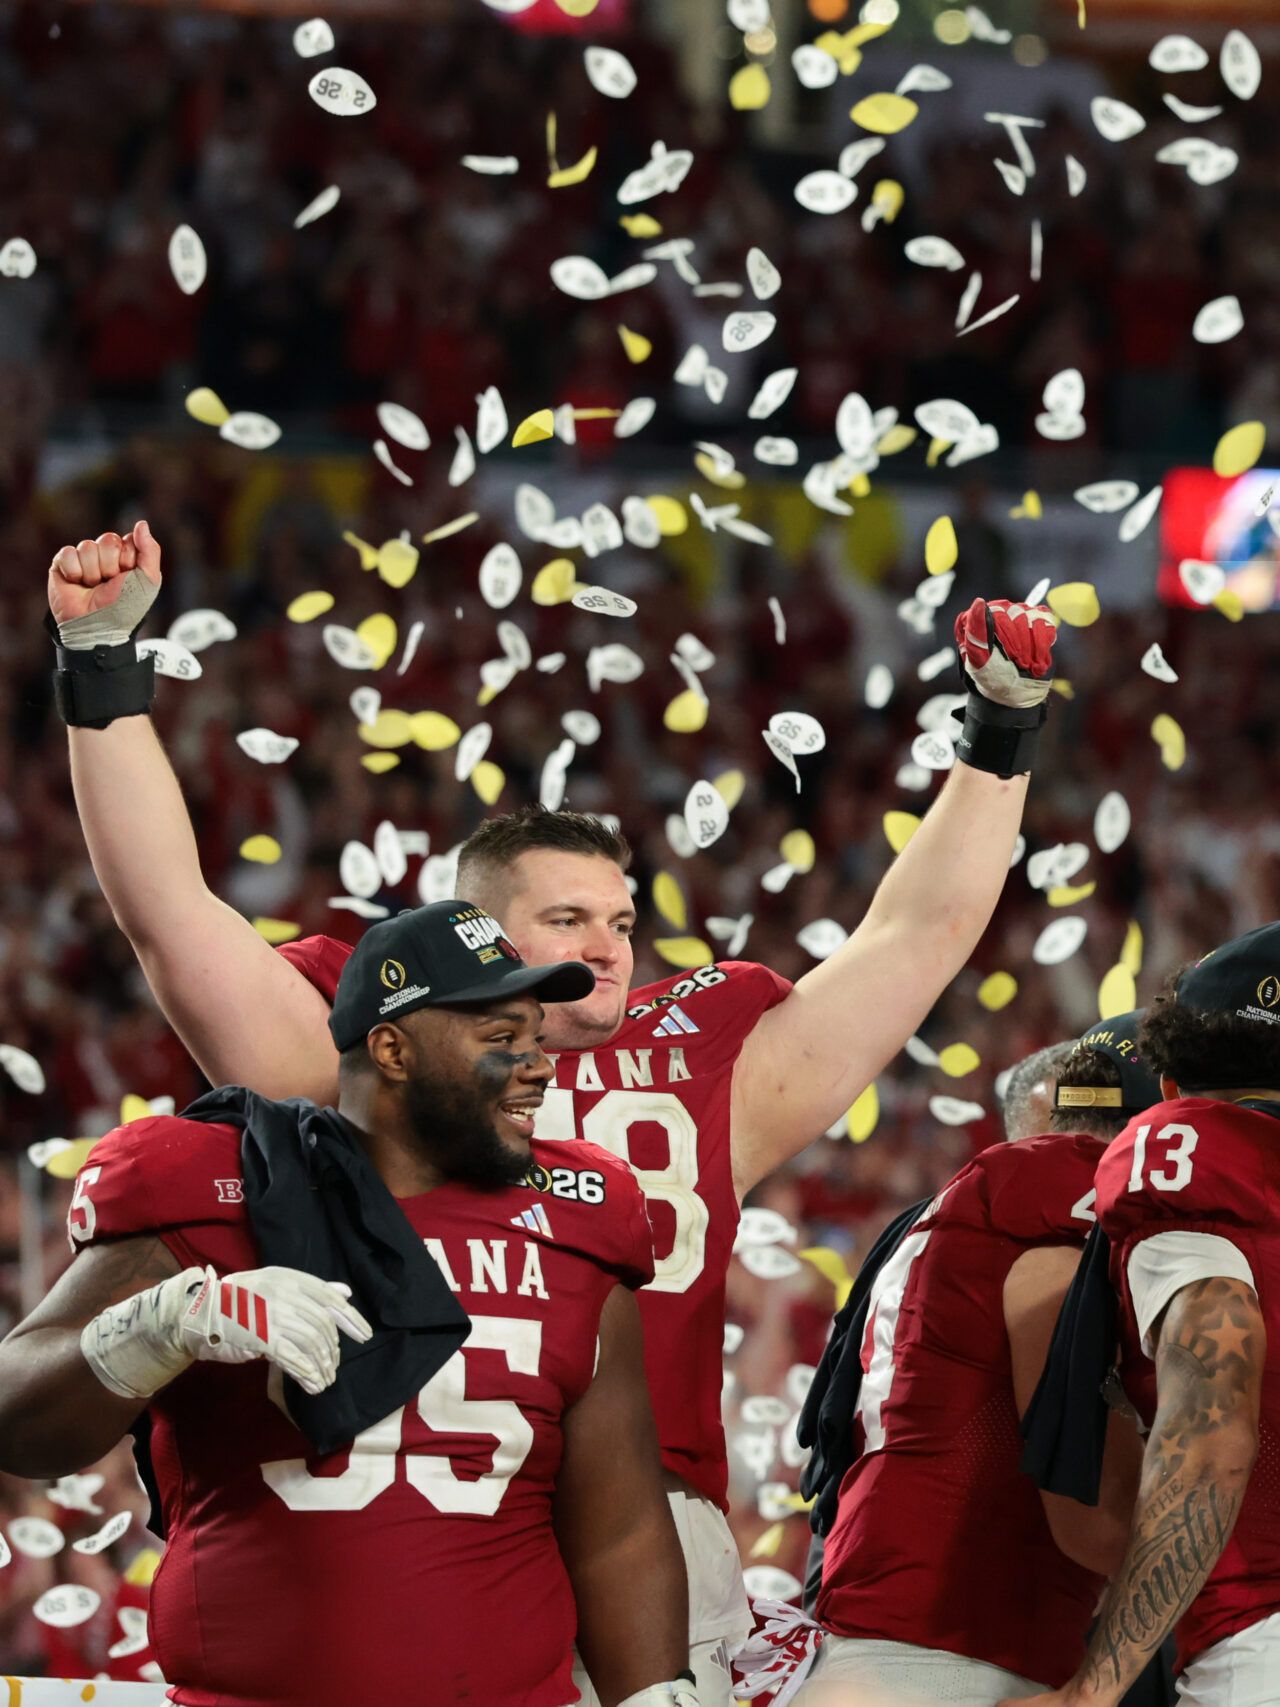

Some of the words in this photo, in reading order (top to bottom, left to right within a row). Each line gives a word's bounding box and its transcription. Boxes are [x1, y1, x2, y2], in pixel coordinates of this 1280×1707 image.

[378, 986, 431, 1015] CHAMPIONSHIP
[383, 984, 421, 1005] NATIONAL
[1116, 1039, 1134, 1057] FL
[1128, 1123, 1199, 1193] 13
